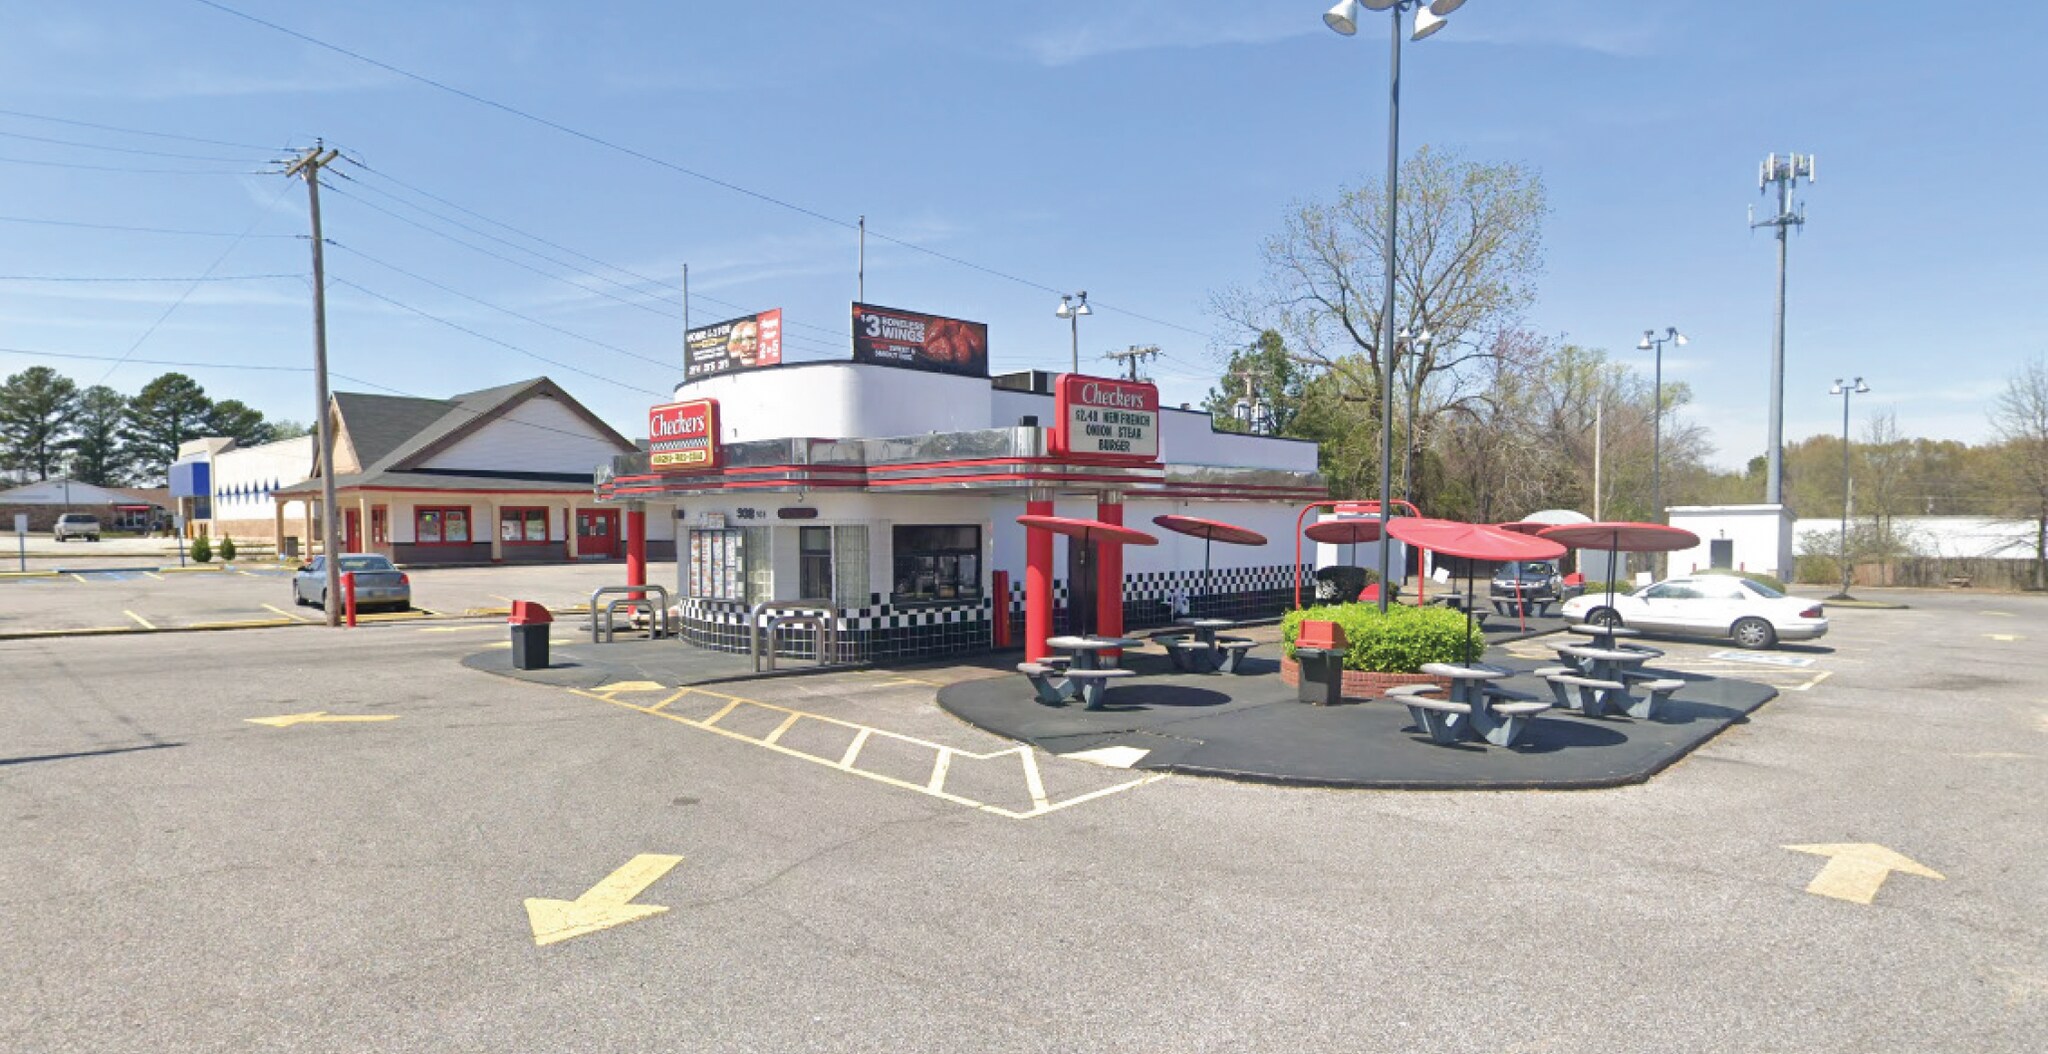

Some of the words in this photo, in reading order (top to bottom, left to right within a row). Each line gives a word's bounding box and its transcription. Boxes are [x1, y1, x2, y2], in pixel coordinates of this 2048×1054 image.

[882, 316, 925, 331] BONELESS
[882, 325, 925, 342] WINGS
[1082, 383, 1144, 408] Checkers
[651, 410, 705, 438] Checkers
[1103, 411, 1119, 424] NEW
[1120, 412, 1150, 427] FRENCH
[1086, 424, 1112, 437] ONION
[1118, 426, 1142, 439] STEAK
[1098, 439, 1131, 452] BURGER
